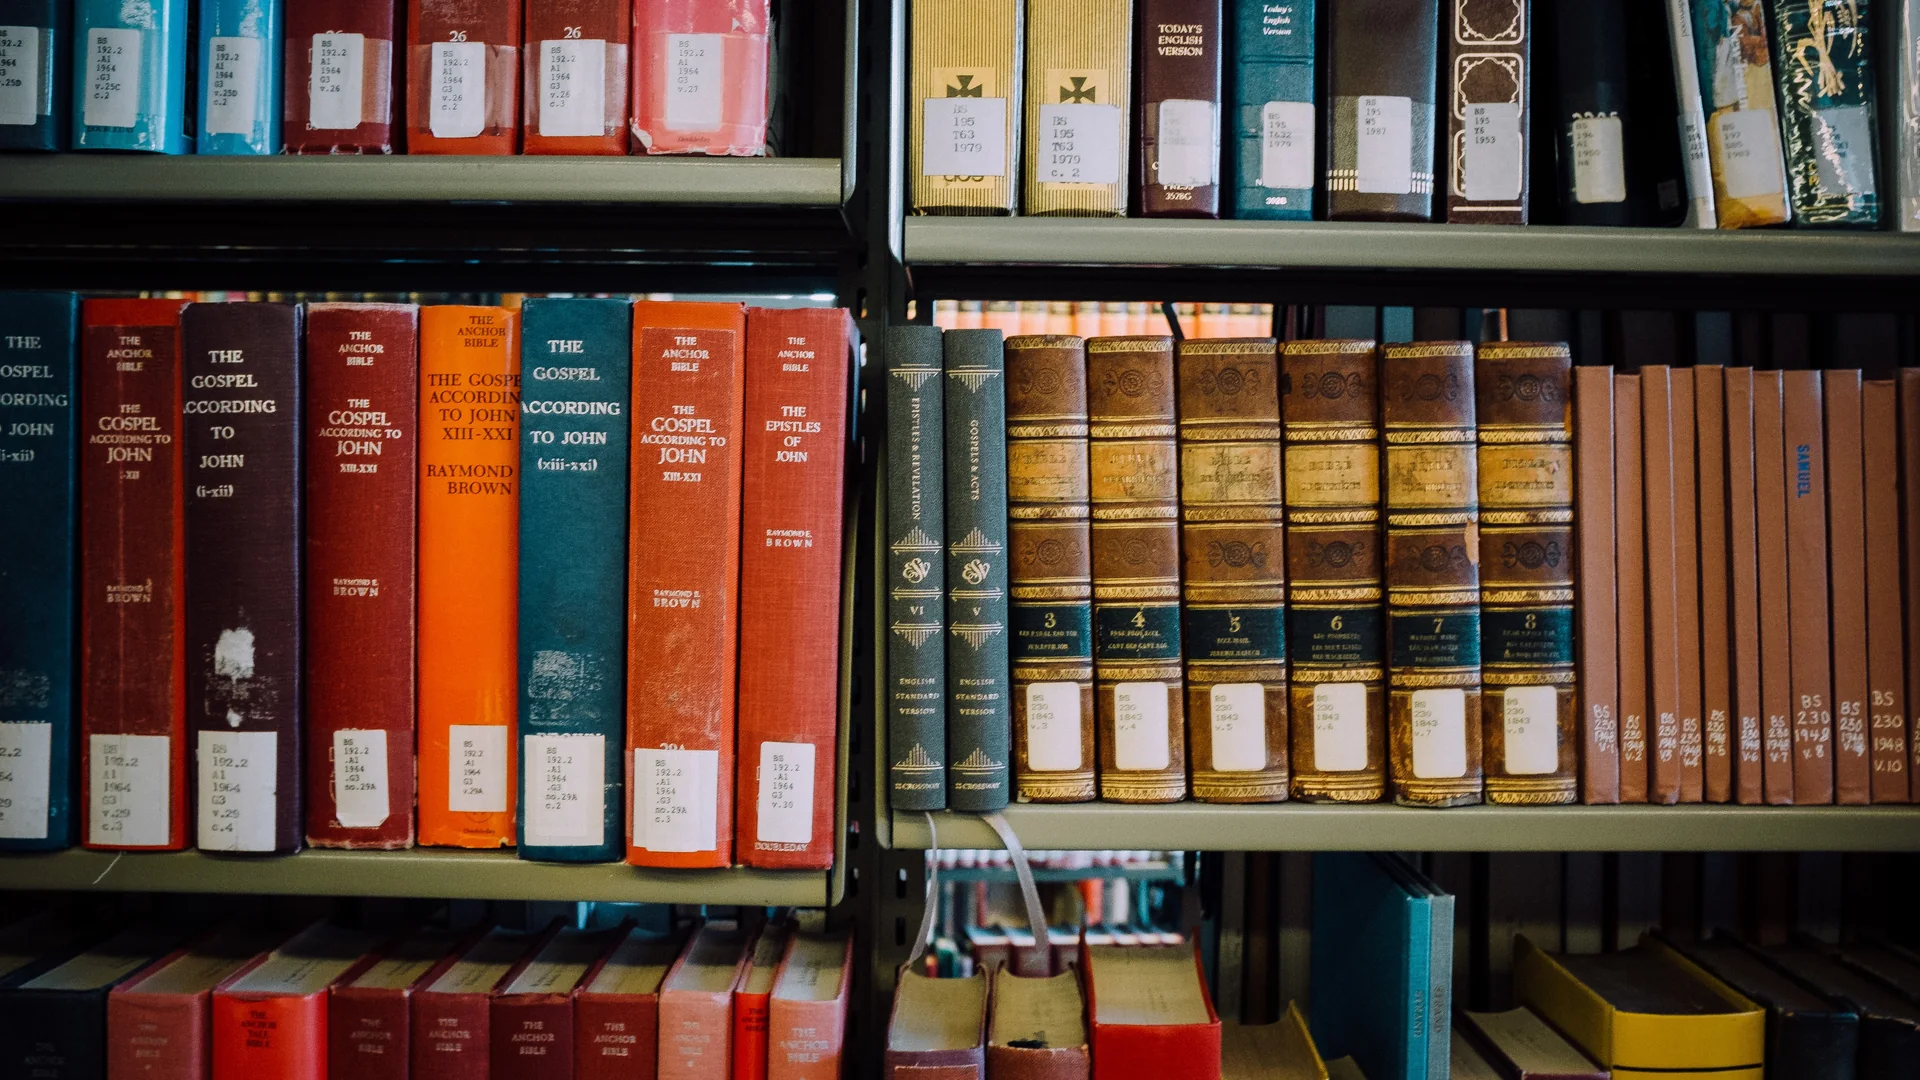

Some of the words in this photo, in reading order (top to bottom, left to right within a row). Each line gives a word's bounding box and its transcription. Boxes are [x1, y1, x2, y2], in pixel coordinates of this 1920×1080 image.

[1263, 5, 1292, 15] Today's
[1263, 16, 1291, 26] English
[564, 26, 581, 39] 26
[1158, 24, 1202, 34] TODAY'S
[1263, 28, 1292, 36] Version
[449, 30, 467, 42] 26
[1158, 35, 1202, 45] ENGLISH
[96, 46, 122, 55] 192.2
[321, 48, 347, 57] 192.2
[678, 49, 704, 57] 192.2
[1158, 46, 1202, 56] VERSION
[215, 53, 239, 62] 192.2
[442, 58, 469, 67] 192.2
[551, 55, 576, 64] 192.2
[96, 64, 116, 72] 1964
[320, 67, 341, 75] 1964
[677, 67, 699, 75] 1964
[214, 71, 233, 79] 1964
[550, 73, 570, 81] 1964
[677, 76, 688, 84] G3
[442, 76, 463, 85] 1964
[319, 84, 341, 93] v.26
[677, 85, 698, 93] v.27
[441, 103, 458, 111] c.2
[1366, 108, 1381, 116] 195
[953, 117, 975, 126] 195
[1474, 117, 1490, 125] 195
[953, 130, 974, 140] T63
[1052, 129, 1074, 139] 195
[1365, 127, 1386, 135] 1987
[1475, 136, 1496, 144] 1953
[953, 143, 982, 152] 1979
[1052, 142, 1074, 152] T63
[1052, 155, 1081, 165] 1979
[469, 316, 494, 325] THE
[349, 331, 371, 341] THE
[457, 327, 506, 336] ANCHOR
[5, 337, 41, 349] THE
[119, 336, 141, 346] THE
[464, 338, 499, 348] BIBLE
[674, 337, 697, 346] THE
[787, 337, 806, 346] THE
[338, 344, 384, 354] ANCHOR
[548, 340, 583, 353] THE
[106, 349, 153, 359] ANCHOR
[208, 351, 243, 363] THE
[662, 350, 709, 359] ANCHOR
[777, 350, 815, 359] ANCHOR
[346, 357, 374, 366] BIBLE
[670, 363, 699, 372] BIBLE
[782, 364, 809, 373] BIBLE
[533, 367, 600, 381] GOSPEL
[192, 375, 257, 388] GOSPEL
[428, 374, 461, 387] THE
[469, 374, 521, 388] GOSPE
[429, 391, 521, 404] ACCORDIN
[120, 404, 141, 414] THE
[183, 401, 276, 414] CCORDING
[347, 399, 370, 409] THE
[521, 401, 621, 415] ACCORDING
[672, 405, 695, 414] THE
[781, 407, 806, 417] THE
[329, 411, 391, 426] GOSPEL
[439, 409, 461, 422] TO
[469, 409, 516, 424] JOHN
[911, 397, 920, 443] EPISTLES
[99, 417, 160, 431] GOSPEL
[651, 417, 716, 433] GOSPEL
[766, 421, 821, 433] EPISTLES
[9, 424, 54, 436] JOHN
[211, 427, 234, 439] TO
[318, 429, 381, 438] ACCORDING
[384, 429, 402, 439] TO
[442, 428, 513, 440] XIII-XXI
[89, 434, 152, 444] ACCORDING
[153, 434, 171, 444] TO
[529, 431, 554, 444] TO
[561, 431, 607, 445] JOHN
[640, 436, 708, 446] ACCORDING
[709, 437, 726, 446] TO
[783, 436, 801, 447] OF
[970, 419, 980, 462] GOSPELS
[335, 441, 382, 456] JOHN
[107, 447, 152, 463] JOHN
[658, 448, 706, 464] JOHN
[775, 452, 808, 462] JOHN
[200, 455, 244, 468] JOHN
[537, 458, 598, 471] (xiii-xxi)
[340, 464, 377, 473] XIII-XXI
[427, 465, 513, 478] RAYMOND
[1796, 444, 1810, 498] SAMUEL
[663, 472, 701, 482] XIII-XXI
[197, 485, 233, 498] (i-xii)
[447, 482, 512, 495] BROWN
[911, 453, 921, 520] REVELATION
[971, 475, 980, 501] ACTS
[765, 538, 813, 548] BROWN
[334, 587, 378, 597] BROWN
[654, 598, 700, 608] BROWN
[909, 606, 924, 616] VI
[972, 607, 982, 616] V
[1044, 613, 1056, 628] 3
[1131, 612, 1145, 628] 4
[1229, 615, 1241, 632] 5
[1331, 615, 1342, 630] 6
[1433, 617, 1444, 633] 7
[1524, 614, 1536, 629] 8
[899, 677, 936, 686] ENGLISH
[959, 678, 995, 686] ENGLISH
[895, 692, 940, 700] STANDARD
[955, 692, 1000, 700] STANDARD
[1872, 690, 1894, 706] BS
[1801, 695, 1821, 708] BS
[899, 707, 936, 716] VERSION
[959, 708, 996, 716] VERSION
[1031, 703, 1048, 711] 230
[1593, 704, 1610, 718] BS
[1841, 701, 1860, 715] BS
[1660, 713, 1675, 724] BS
[1711, 710, 1725, 721] BS
[1798, 711, 1830, 724] 230
[1507, 717, 1530, 725] 1843
[1595, 720, 1615, 730] 230
[1626, 715, 1640, 729] BS
[1683, 718, 1697, 732] BS
[1742, 717, 1755, 729] BS
[1770, 715, 1785, 728] BS
[1873, 715, 1903, 728] 230
[1623, 730, 1642, 740] 230
[1658, 725, 1677, 737] 230
[1768, 728, 1788, 738] 230
[1795, 727, 1829, 742] 1948
[1680, 734, 1700, 744] 230
[1874, 738, 1904, 752] 1948
[344, 747, 369, 755] 192.2
[103, 758, 139, 767] 192.2
[212, 758, 248, 767] 192.2
[773, 763, 801, 772] 192.2
[655, 768, 682, 777] 192.2
[103, 783, 131, 793] 1964
[655, 787, 676, 795] 1964
[772, 782, 794, 790] 1964
[772, 800, 794, 809] v.30
[655, 806, 688, 814] no.29A
[655, 815, 671, 823] c.3
[211, 823, 233, 832] c.4
[523, 1021, 544, 1030] THE
[511, 1033, 555, 1042] ANCHOR
